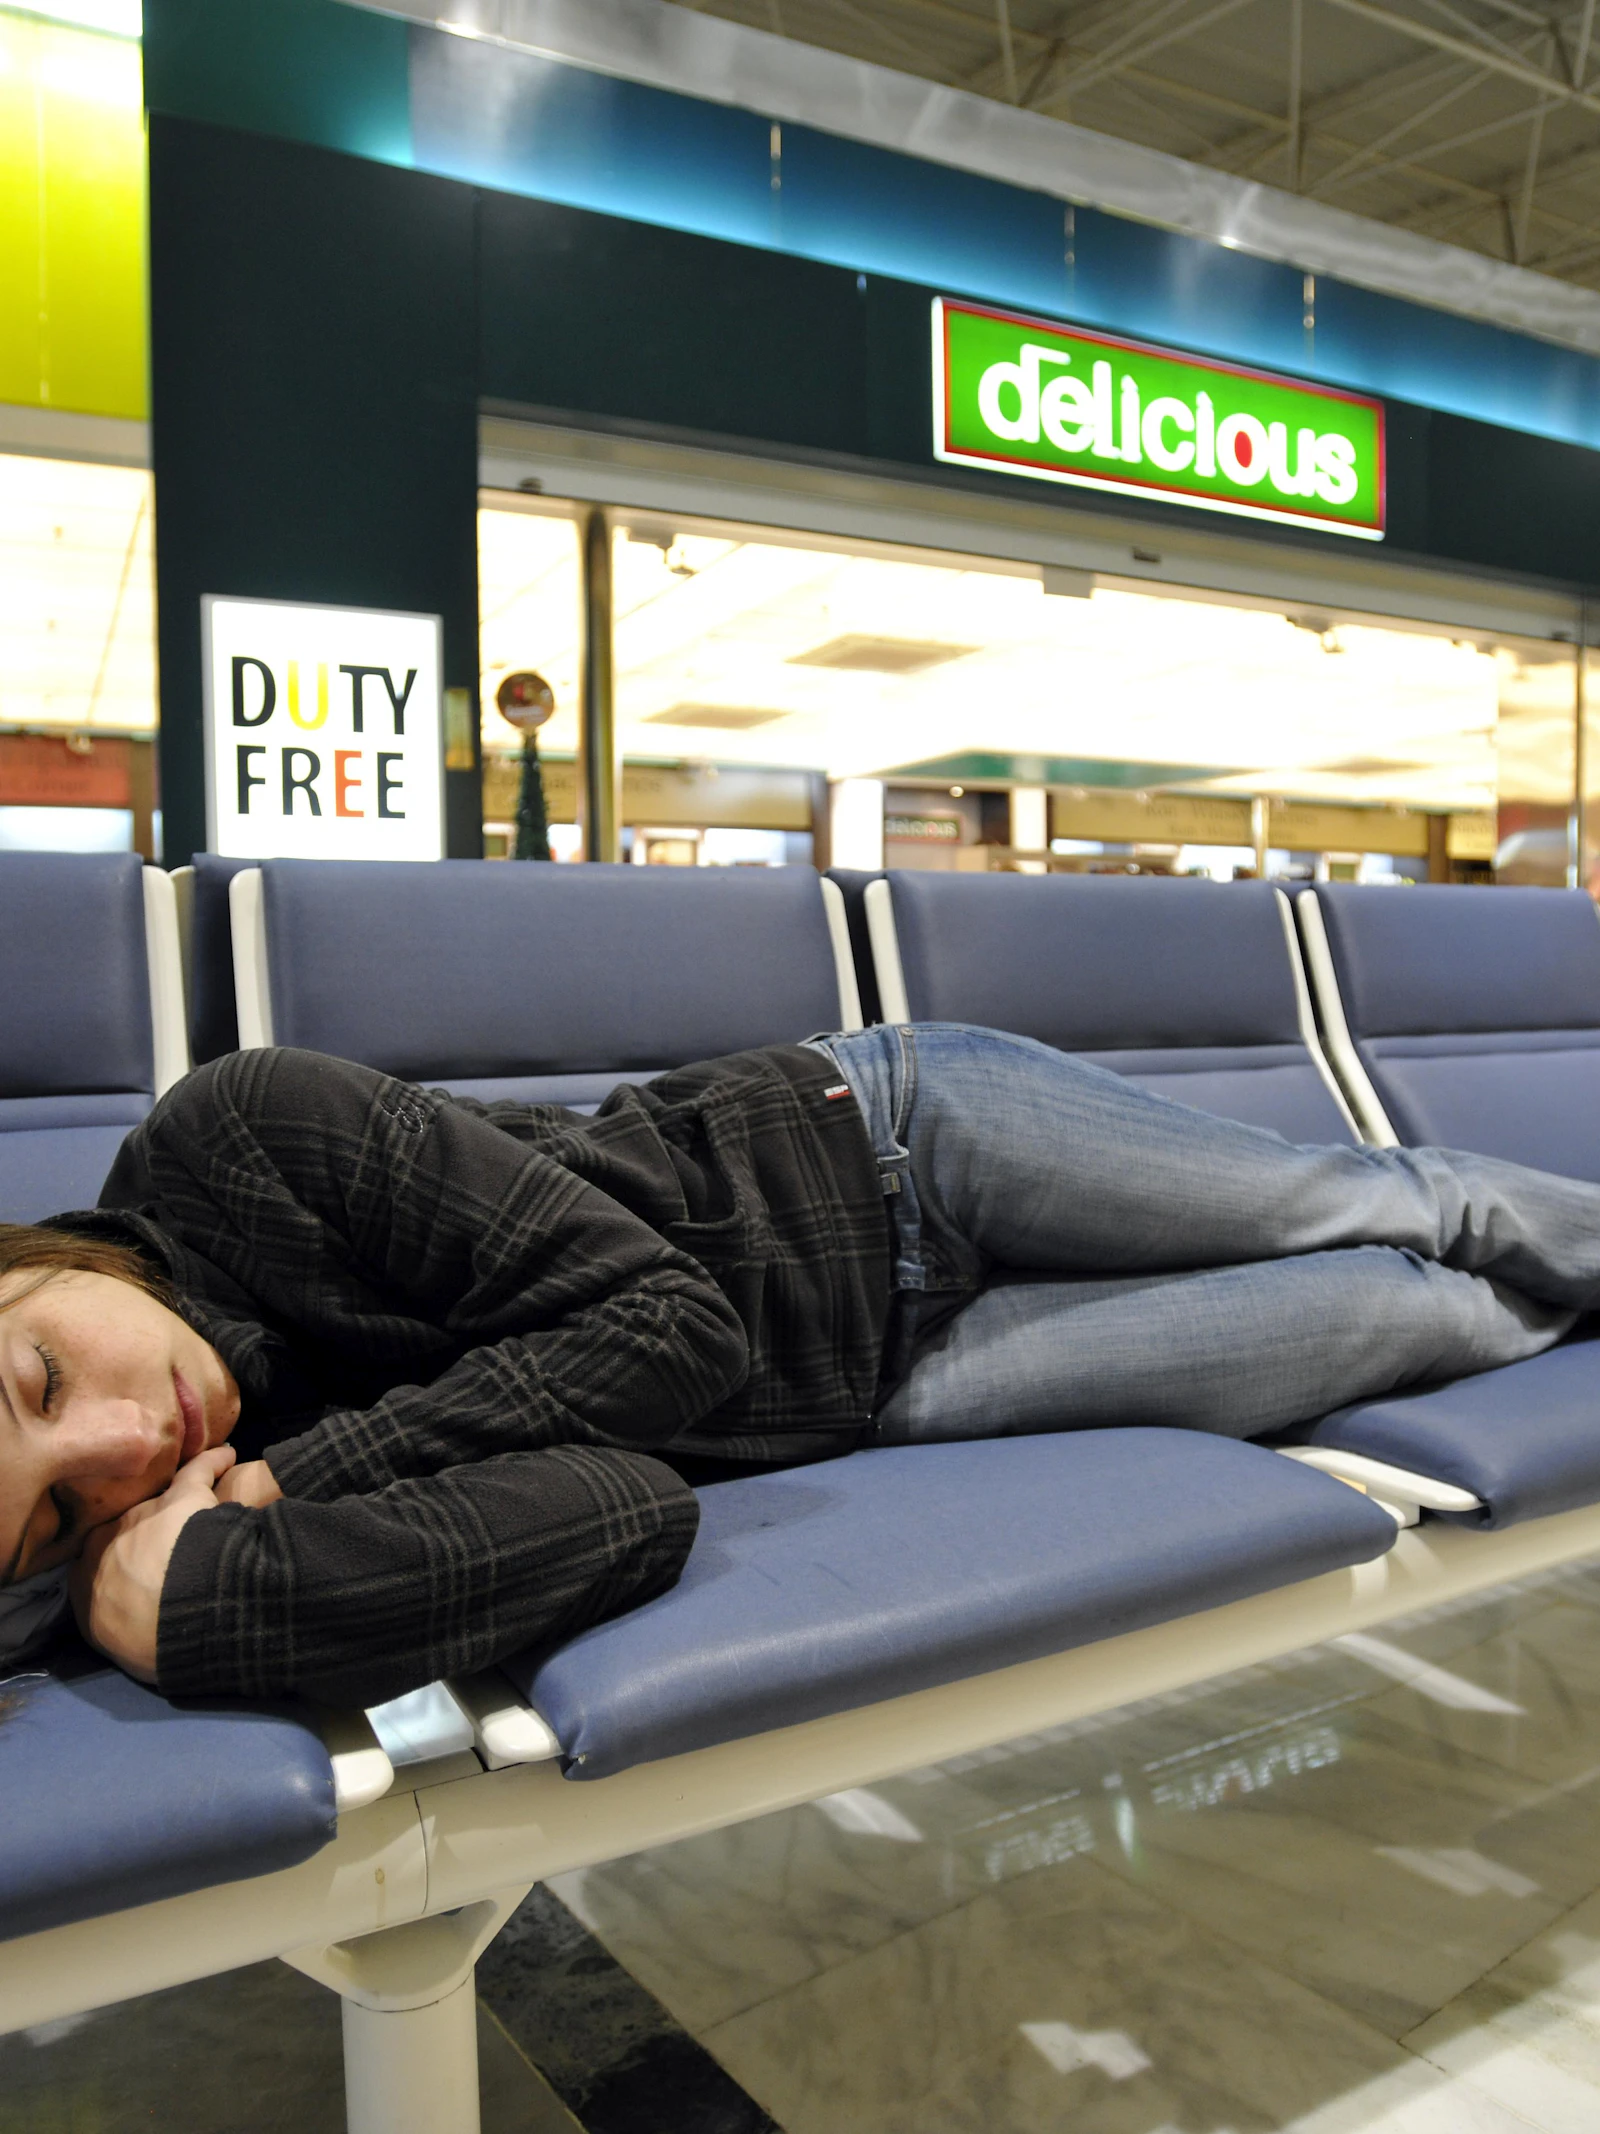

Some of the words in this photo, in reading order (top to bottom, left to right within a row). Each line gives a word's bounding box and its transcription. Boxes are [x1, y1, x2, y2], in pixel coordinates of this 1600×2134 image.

[977, 343, 1358, 505] delicious
[232, 656, 418, 735] DUTY
[236, 744, 406, 819] FREE
